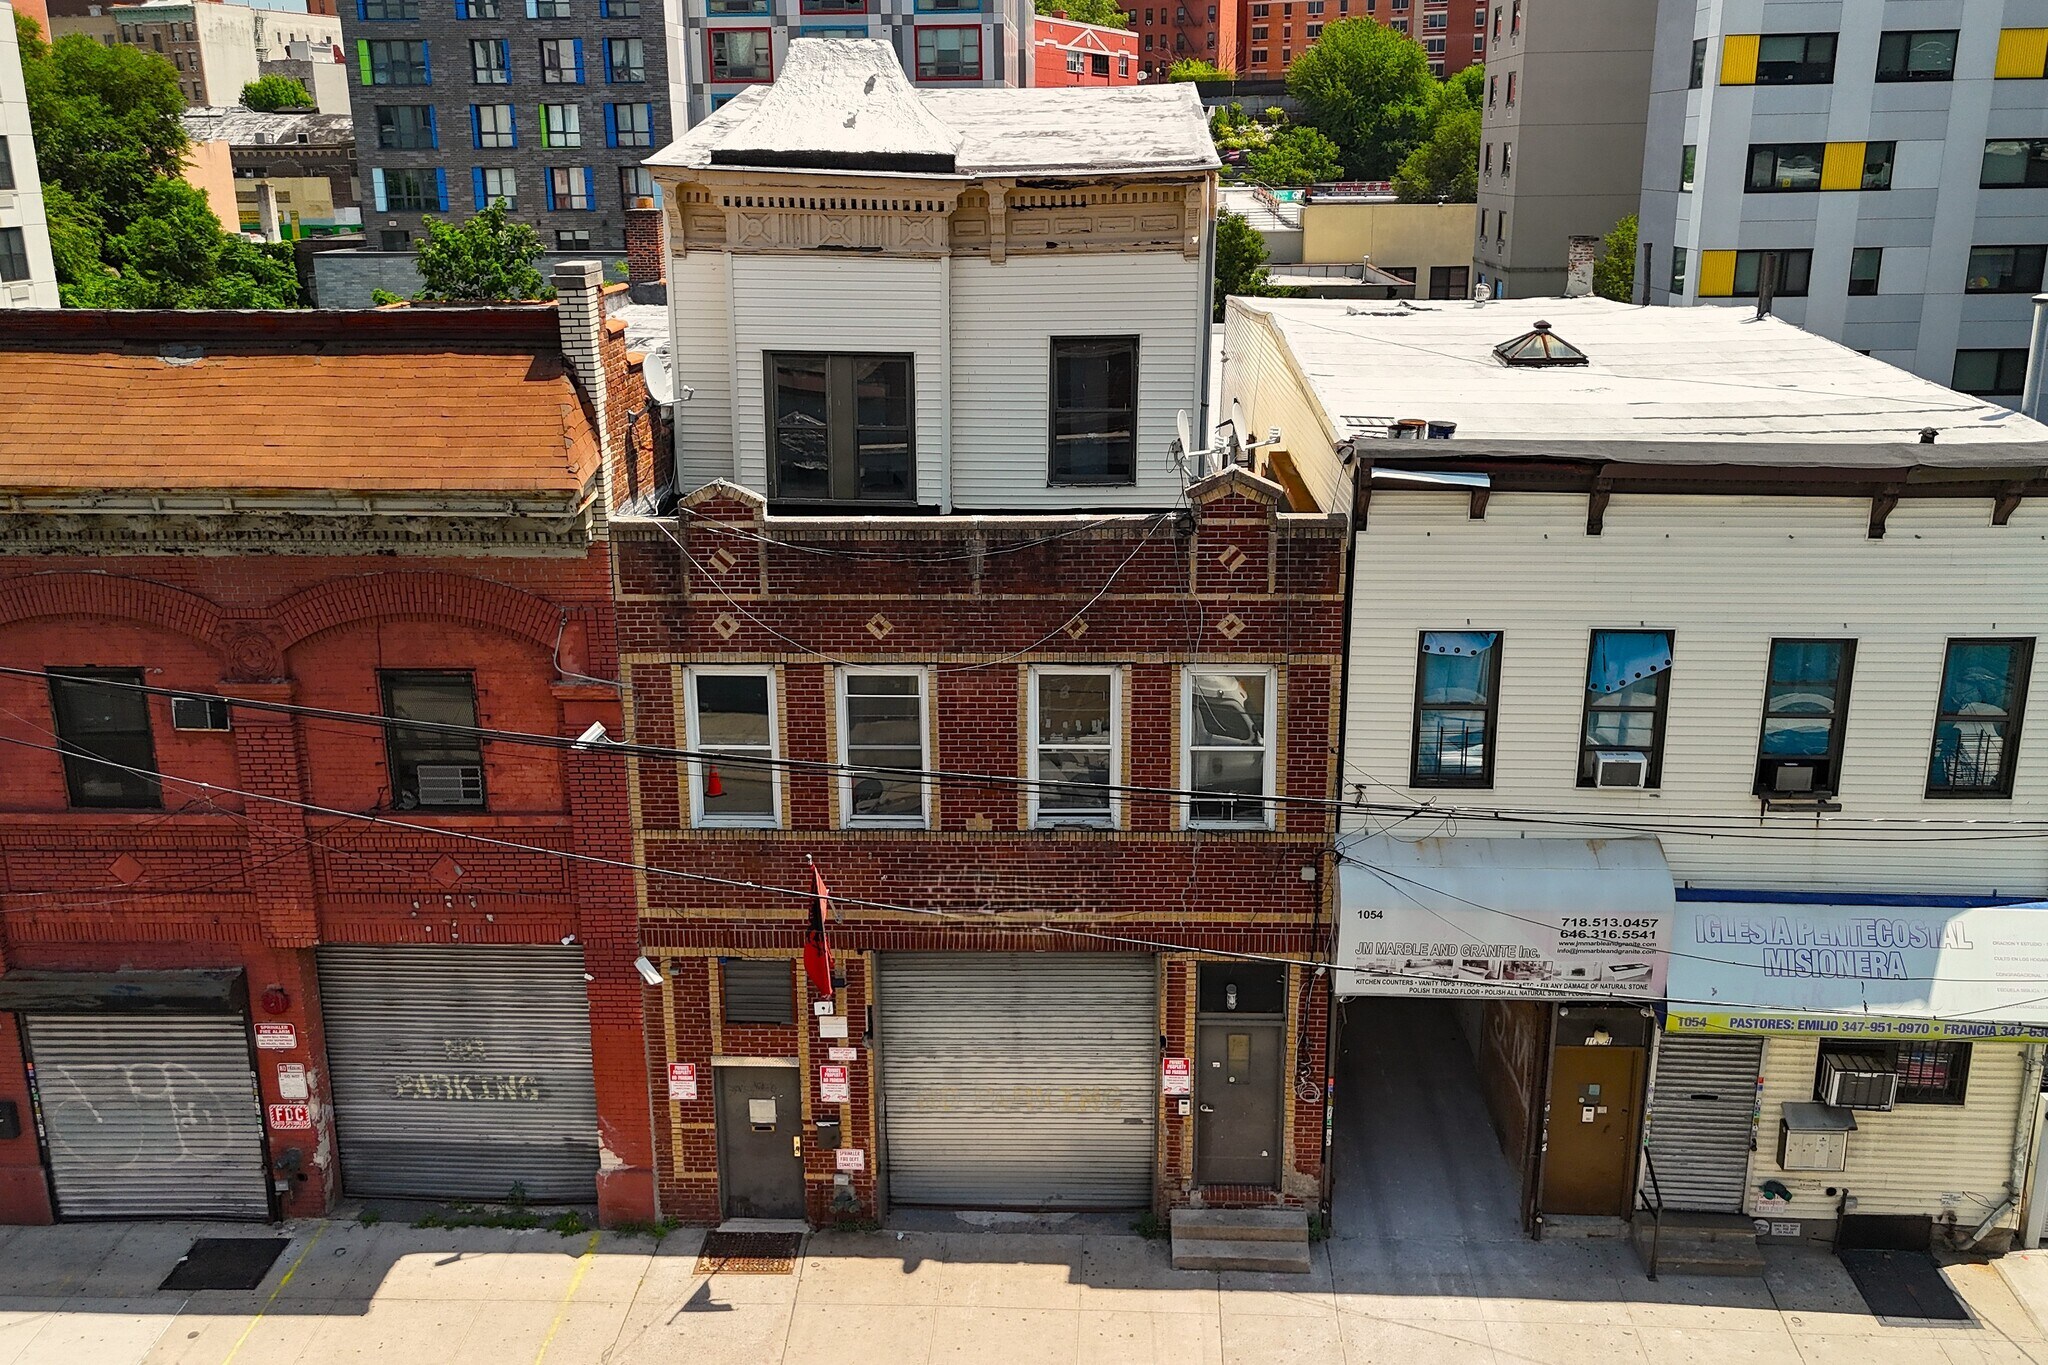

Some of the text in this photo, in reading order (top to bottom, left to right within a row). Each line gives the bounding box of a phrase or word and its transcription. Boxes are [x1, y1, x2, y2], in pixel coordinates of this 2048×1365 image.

[1357, 910, 1383, 919] 1054
[1561, 917, 1659, 928] 718.513.0457
[1560, 929, 1656, 940] 646.316.5541
[1695, 914, 1973, 950] IGLESIA PENTECOSTAL
[1355, 941, 1541, 959] JM MARBLE AND GRANITE Inc.
[1558, 940, 1657, 948] www.jmmarbleandgranite.com
[1556, 948, 1657, 956] info@jmmarbleandgranite.com
[1763, 948, 1908, 980] MISIONERA
[1678, 1017, 1707, 1027] 1054
[1729, 1017, 1794, 1030] PASTORES:
[1797, 1020, 1838, 1031] EMILIO
[1842, 1021, 1930, 1034] 347-951-0970
[1943, 1023, 1997, 1036] FRANCIA
[394, 1073, 539, 1101] PARKING
[275, 1108, 304, 1121] FDC
